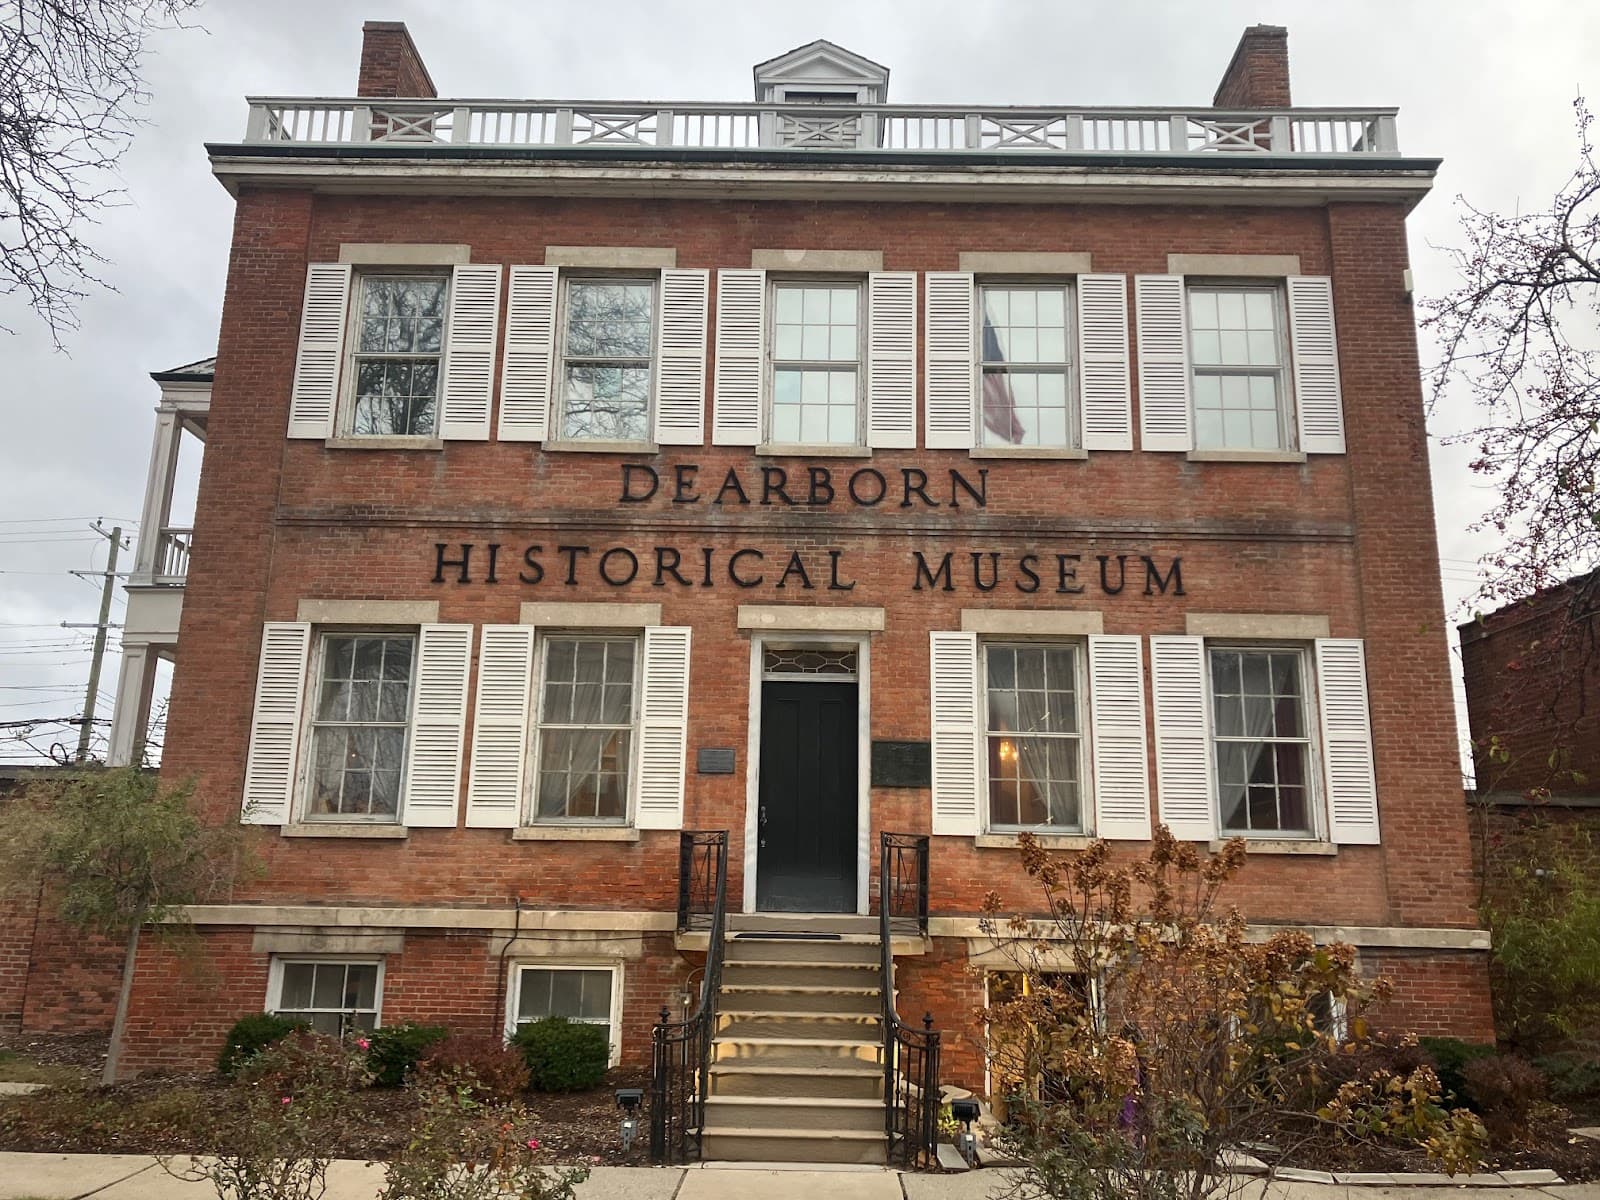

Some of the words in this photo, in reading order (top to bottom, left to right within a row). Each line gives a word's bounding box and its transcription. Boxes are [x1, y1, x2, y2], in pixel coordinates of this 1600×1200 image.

[620, 465, 988, 508] DEARBORN
[432, 543, 856, 590] HISTORICAL
[914, 552, 1185, 596] MUSEUM
